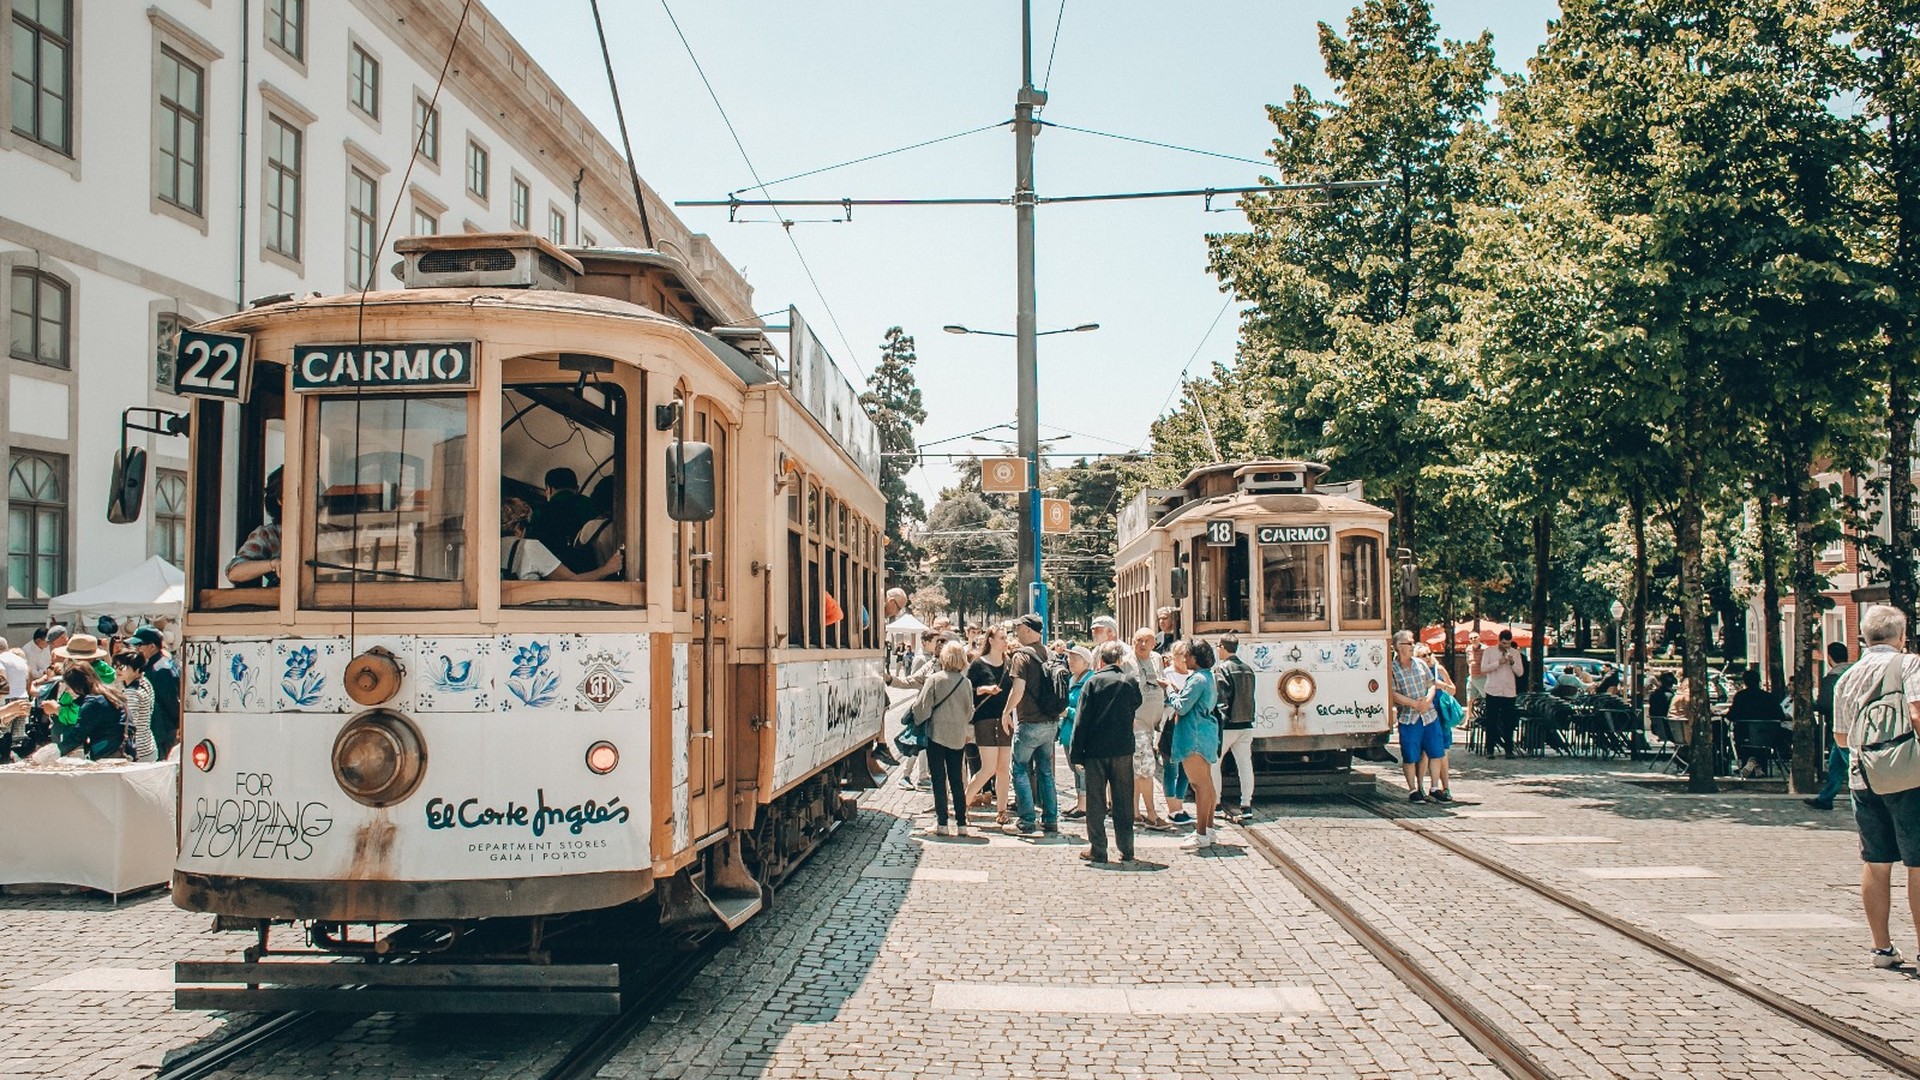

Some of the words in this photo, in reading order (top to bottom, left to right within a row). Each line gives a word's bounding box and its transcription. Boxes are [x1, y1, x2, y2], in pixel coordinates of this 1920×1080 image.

[180, 340, 238, 391] 22
[301, 348, 464, 383] CARMO
[1209, 522, 1231, 542] 18
[1260, 527, 1327, 542] CARMO
[186, 642, 212, 665] 218
[1316, 704, 1329, 716] El
[235, 772, 273, 796] FOR
[190, 797, 333, 837] SHOPPING
[425, 797, 456, 830] El
[457, 797, 529, 829] Corte
[532, 788, 630, 837] Inglés
[191, 823, 320, 861] LOVERS
[468, 841, 552, 852] DEPARTMENT
[559, 839, 608, 850] STORES
[490, 852, 523, 862] GAIA
[542, 850, 588, 861] PORTO
